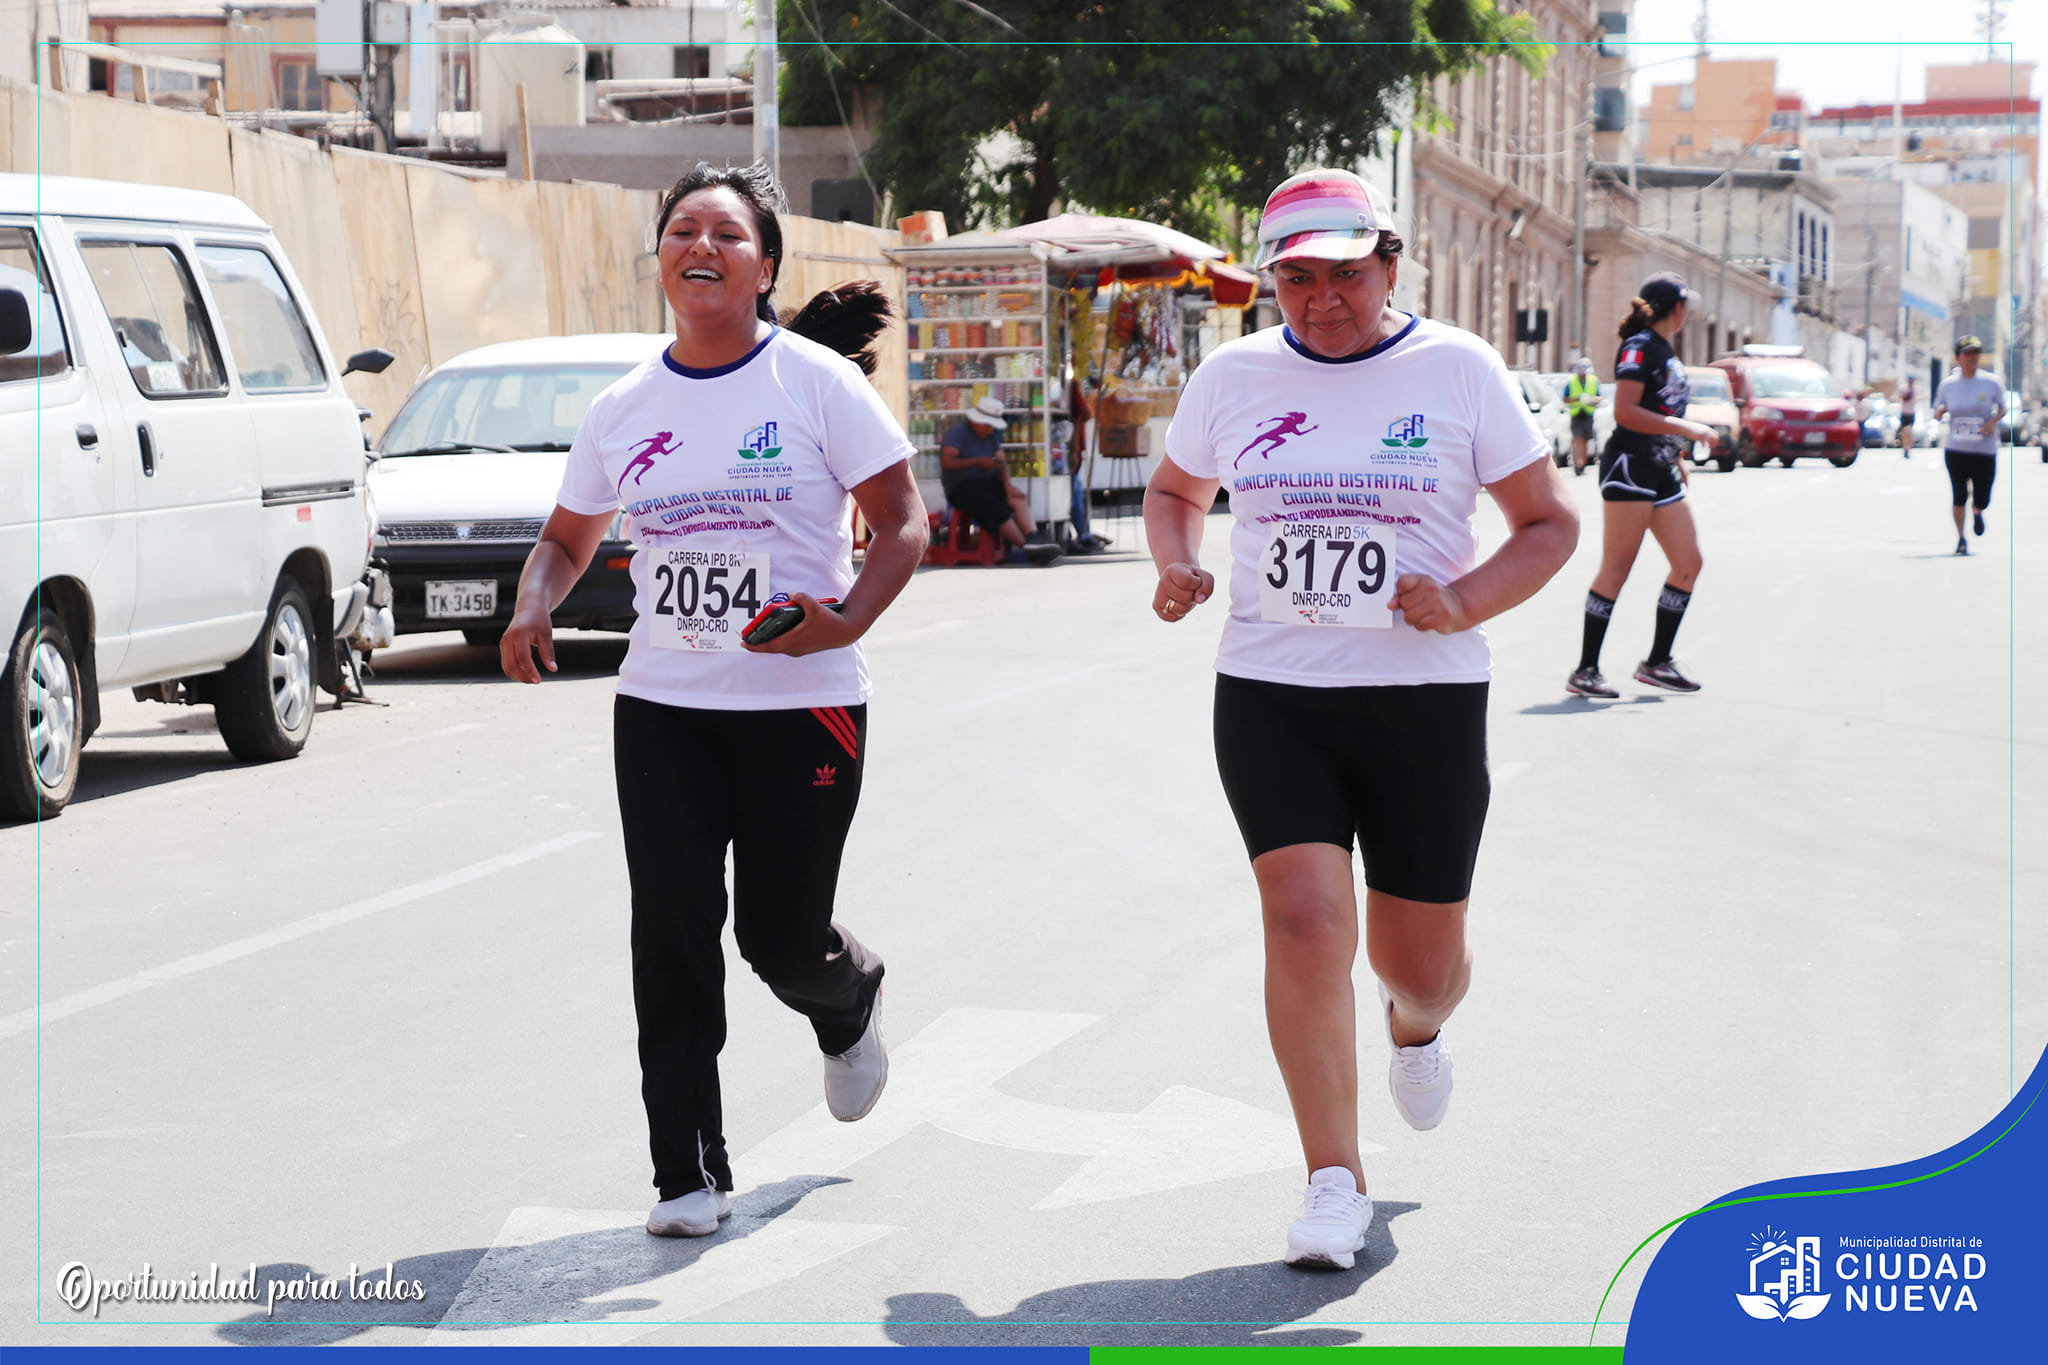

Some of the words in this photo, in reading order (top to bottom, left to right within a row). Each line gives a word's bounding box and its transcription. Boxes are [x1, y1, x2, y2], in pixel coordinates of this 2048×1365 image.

[1409, 455, 1438, 463] NUEVA
[762, 465, 793, 473] NUEVA
[1233, 472, 1334, 493] MUNICIPALIDAD
[1339, 473, 1418, 492] DISTRITAL
[1422, 477, 1439, 493] DE
[702, 488, 772, 502] DISTRITAL
[776, 486, 793, 501] DE
[1281, 491, 1333, 506] CIUDAD
[1336, 493, 1381, 508] NUEVA
[660, 504, 706, 524] CIUDAD
[706, 503, 745, 516] NUEVA
[1299, 508, 1371, 520] EMPODERAMIENTO
[1283, 523, 1332, 539] CARRERA
[1334, 526, 1351, 540] IPD
[1352, 526, 1371, 540] 5K
[668, 551, 709, 566] CARRERA
[711, 553, 726, 567] IPD
[1266, 537, 1386, 594] 3179
[655, 564, 761, 619] 2054
[1292, 591, 1352, 608] DNRPD-CRD
[677, 617, 729, 632] DNRPD-CRD
